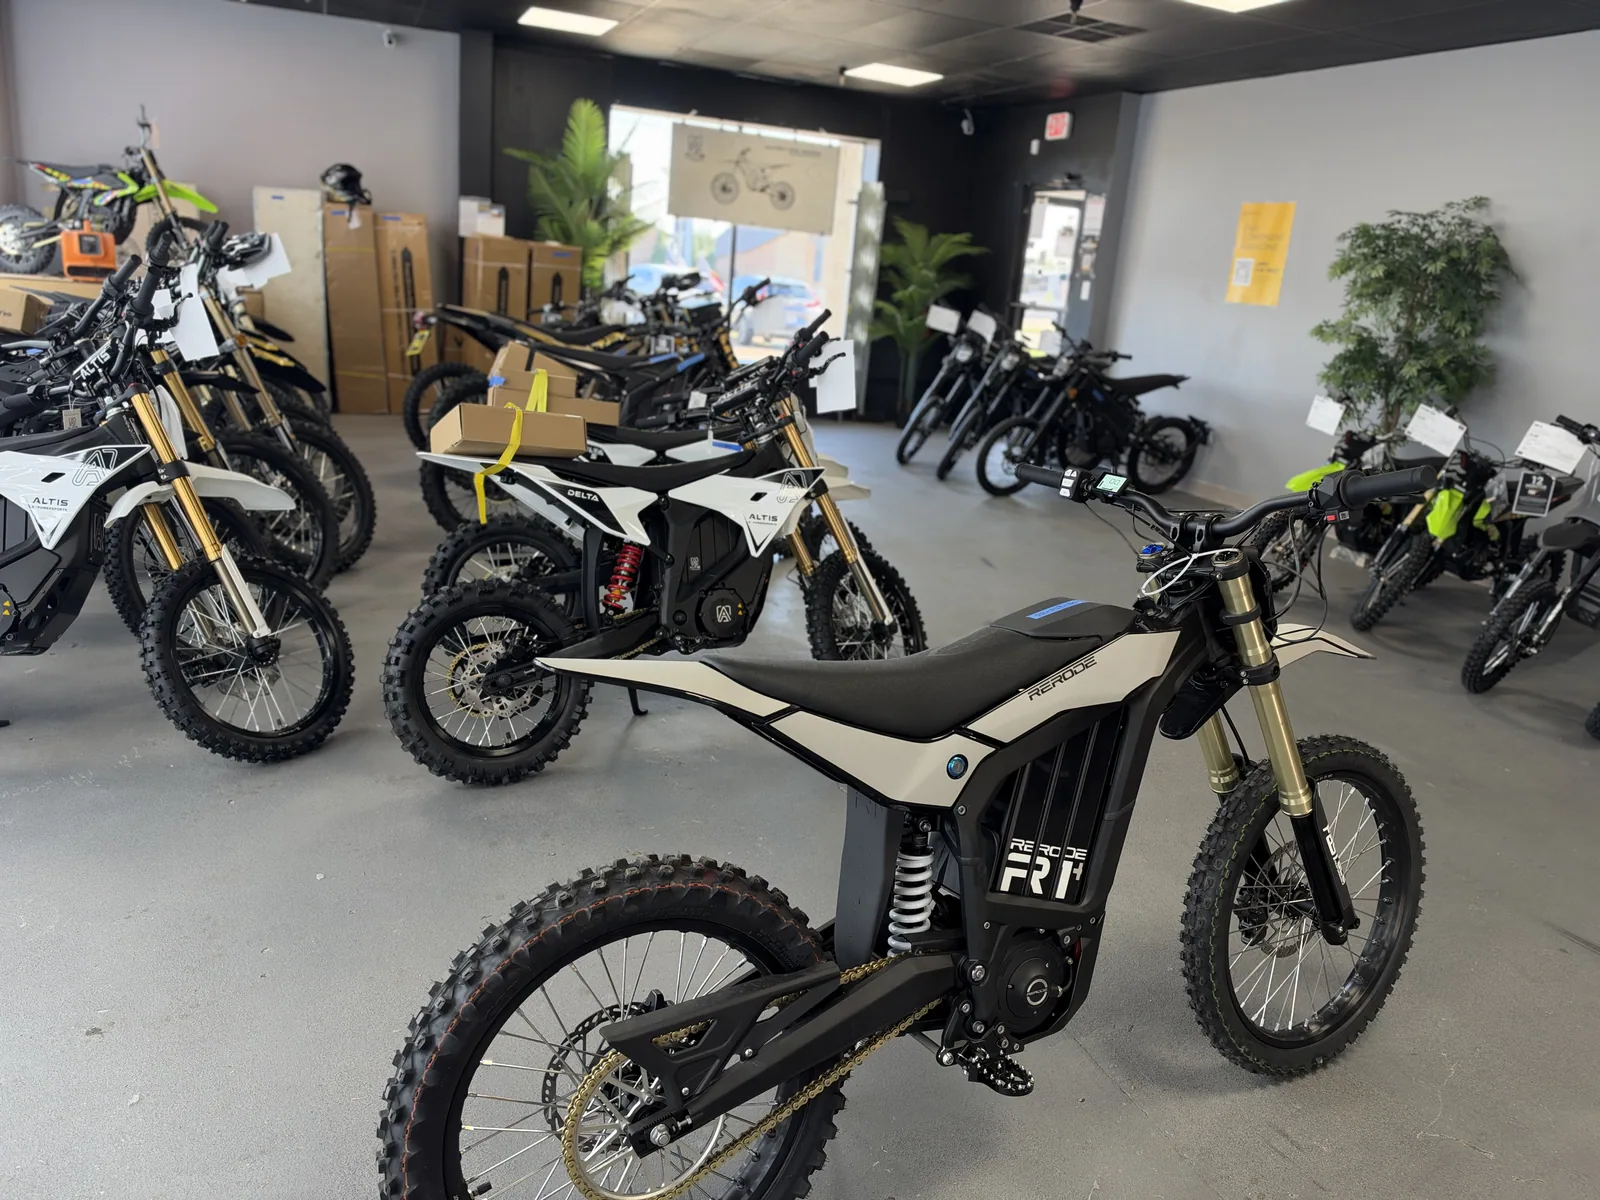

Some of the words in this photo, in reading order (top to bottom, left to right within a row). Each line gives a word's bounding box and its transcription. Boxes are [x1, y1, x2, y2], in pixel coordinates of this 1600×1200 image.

[80, 352, 111, 380] ALTIS
[1531, 475, 1545, 486] 12
[32, 496, 69, 507] ALTIS
[567, 489, 599, 502] DELTA
[748, 513, 778, 522] ALTIS
[1027, 656, 1098, 702] RERODE
[1009, 837, 1088, 861] RERODE
